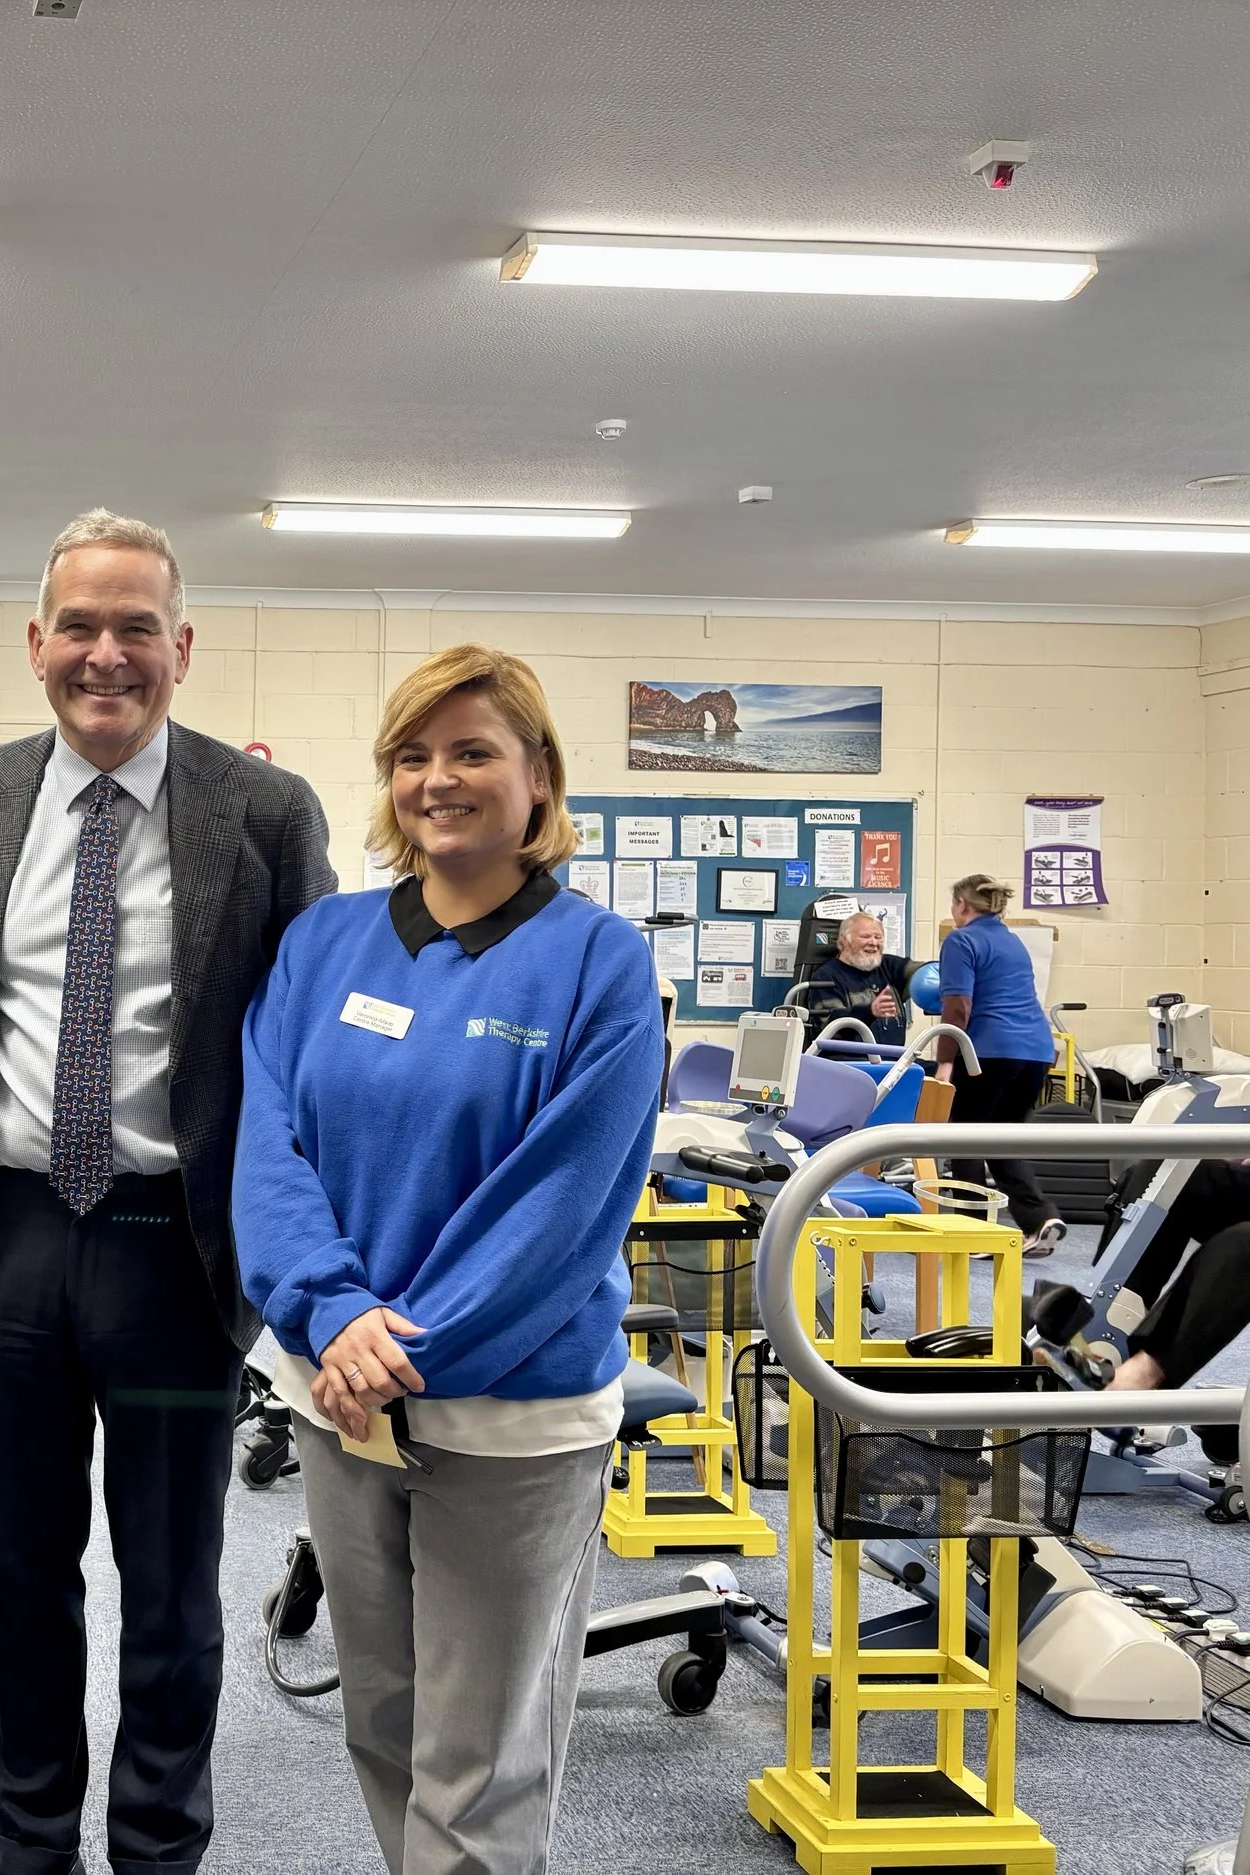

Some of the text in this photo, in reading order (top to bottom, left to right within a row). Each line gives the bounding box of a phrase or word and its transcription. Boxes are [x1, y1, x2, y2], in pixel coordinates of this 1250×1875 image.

[810, 813, 855, 821] DONATIONS
[886, 833, 898, 841] YOU
[488, 1017, 550, 1038] West Berkshire
[488, 1026, 548, 1048] Therapy Centre
